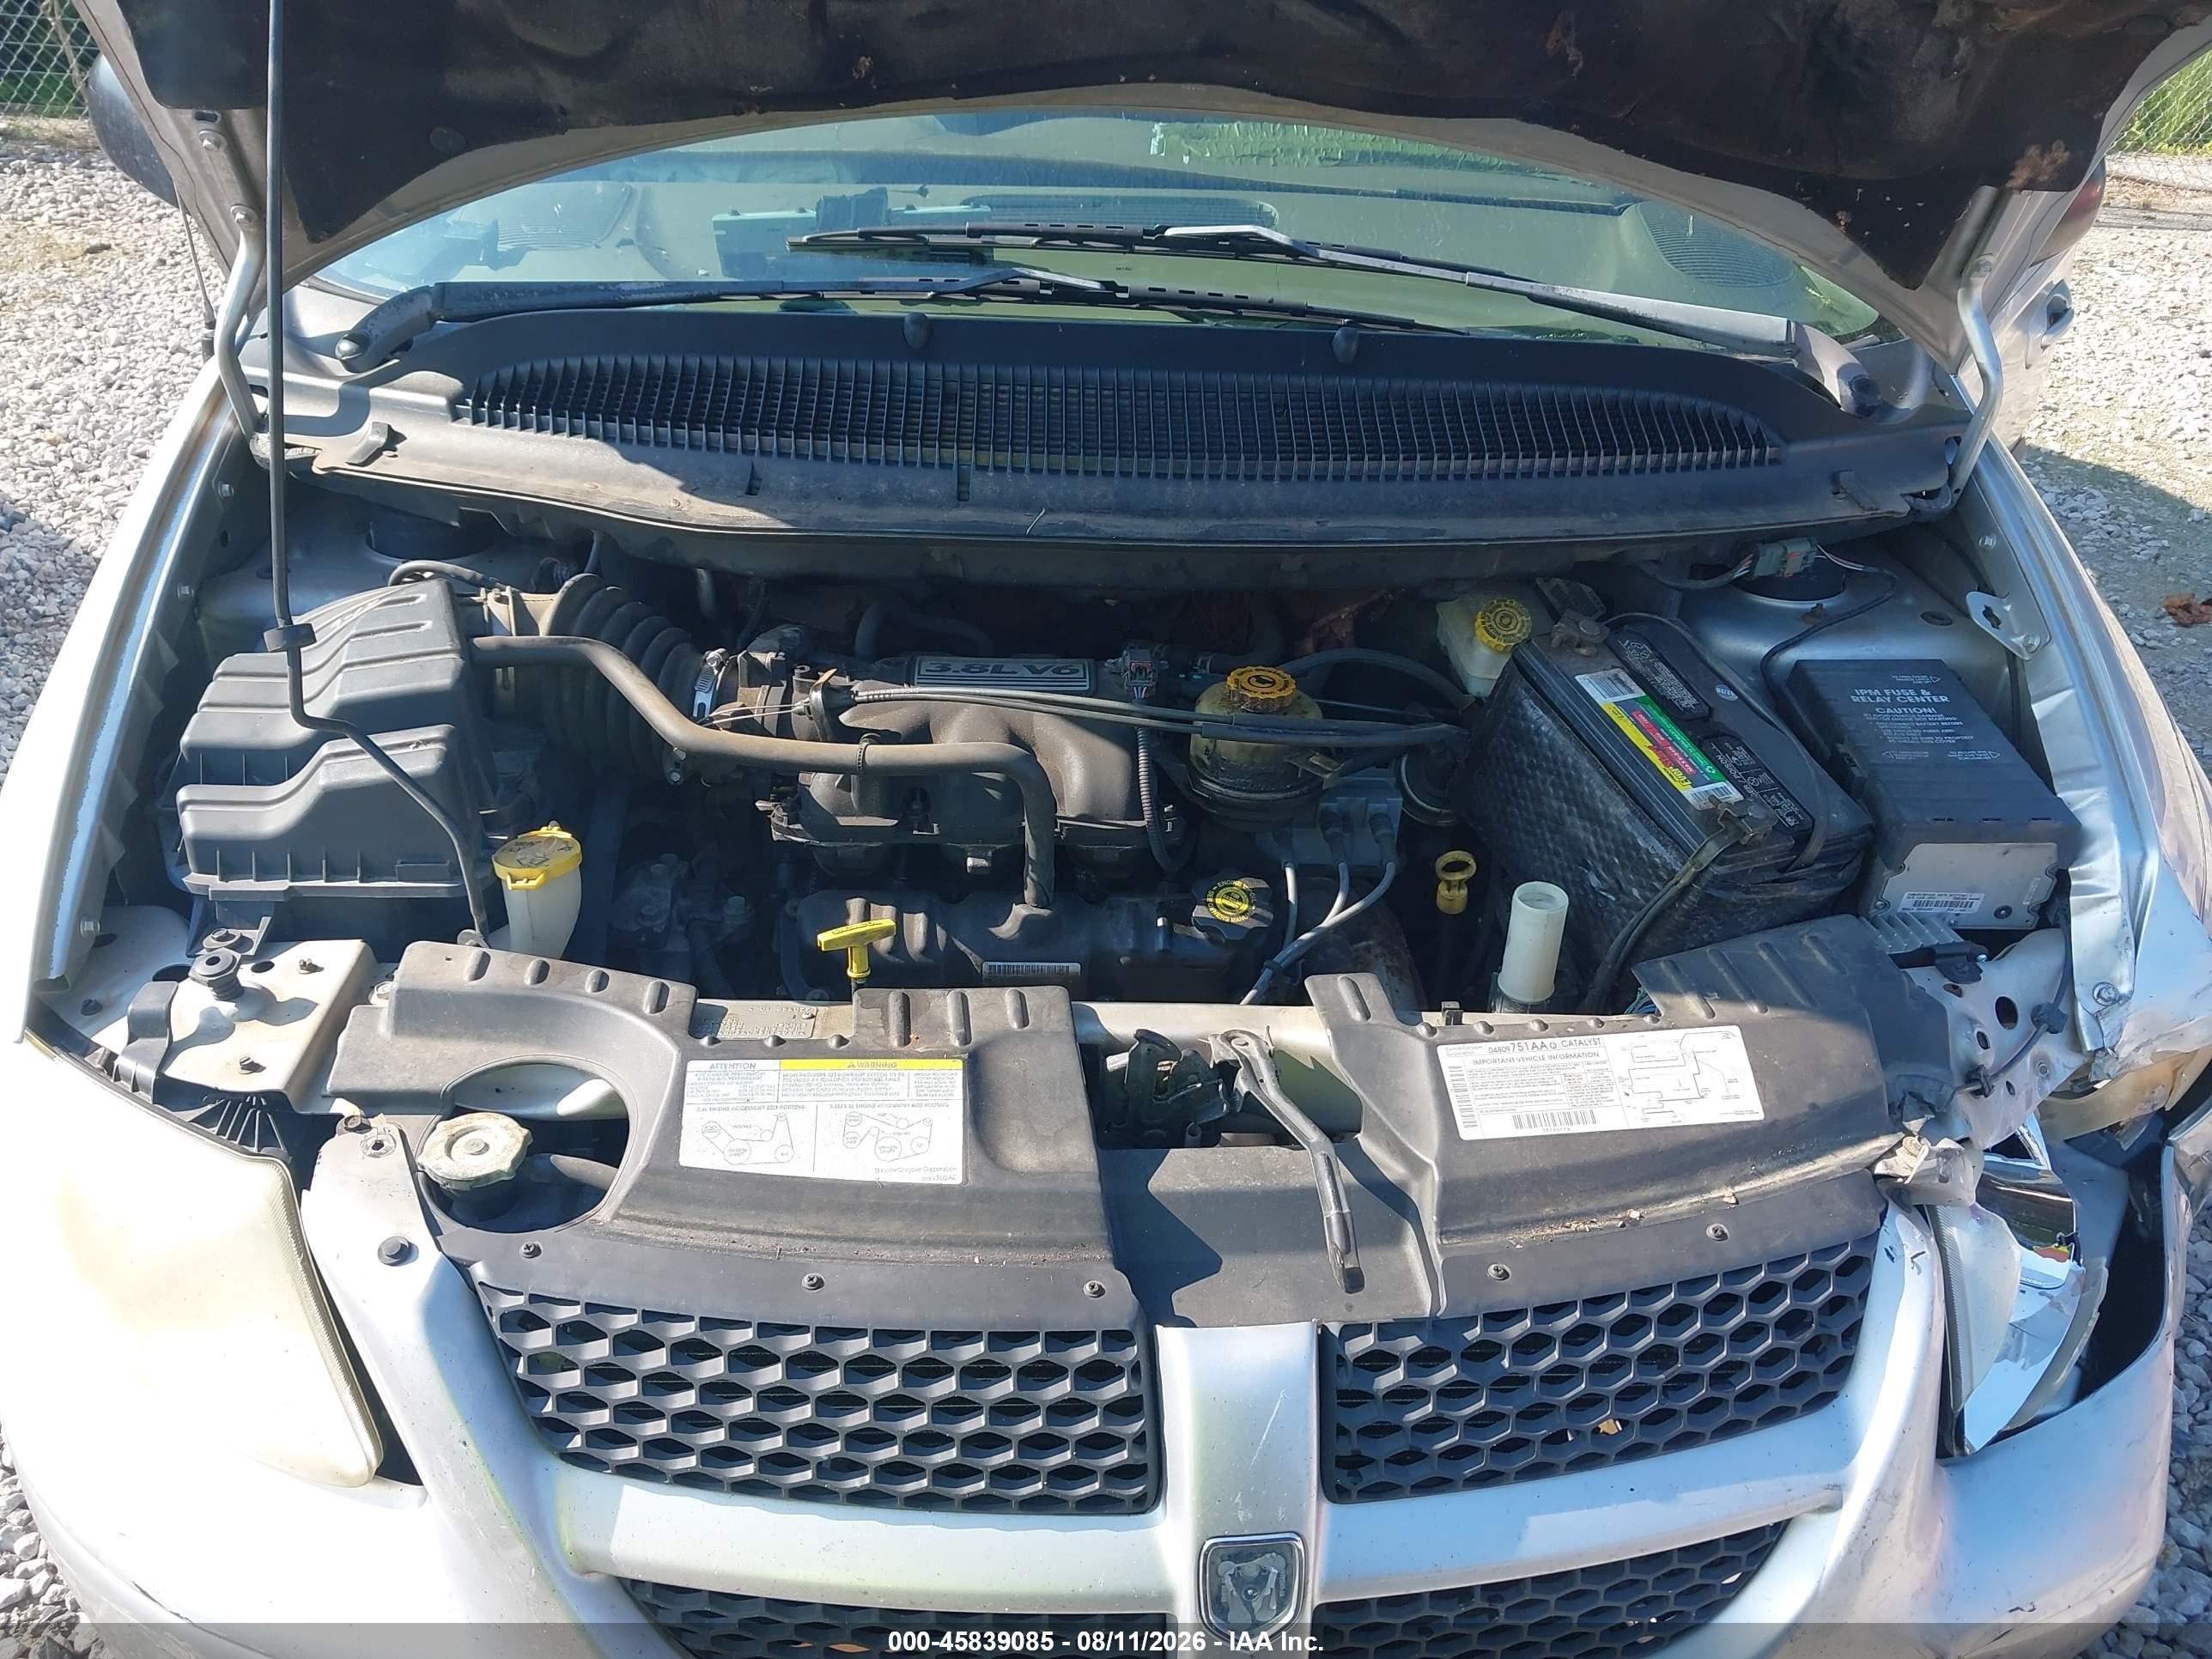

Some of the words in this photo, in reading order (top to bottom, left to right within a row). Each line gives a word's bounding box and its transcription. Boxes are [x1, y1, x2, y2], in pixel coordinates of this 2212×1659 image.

[925, 662, 1018, 675] 3.8L
[1019, 664, 1080, 675] V6
[1716, 754, 1741, 779] POISON
[1217, 879, 1243, 888] ENGINE
[1561, 1038, 1601, 1047] CATALYST
[1473, 1057, 1515, 1066] IMPORTANT
[1518, 1055, 1546, 1063] VEHICLE
[1548, 1051, 1599, 1062] INFORMATION
